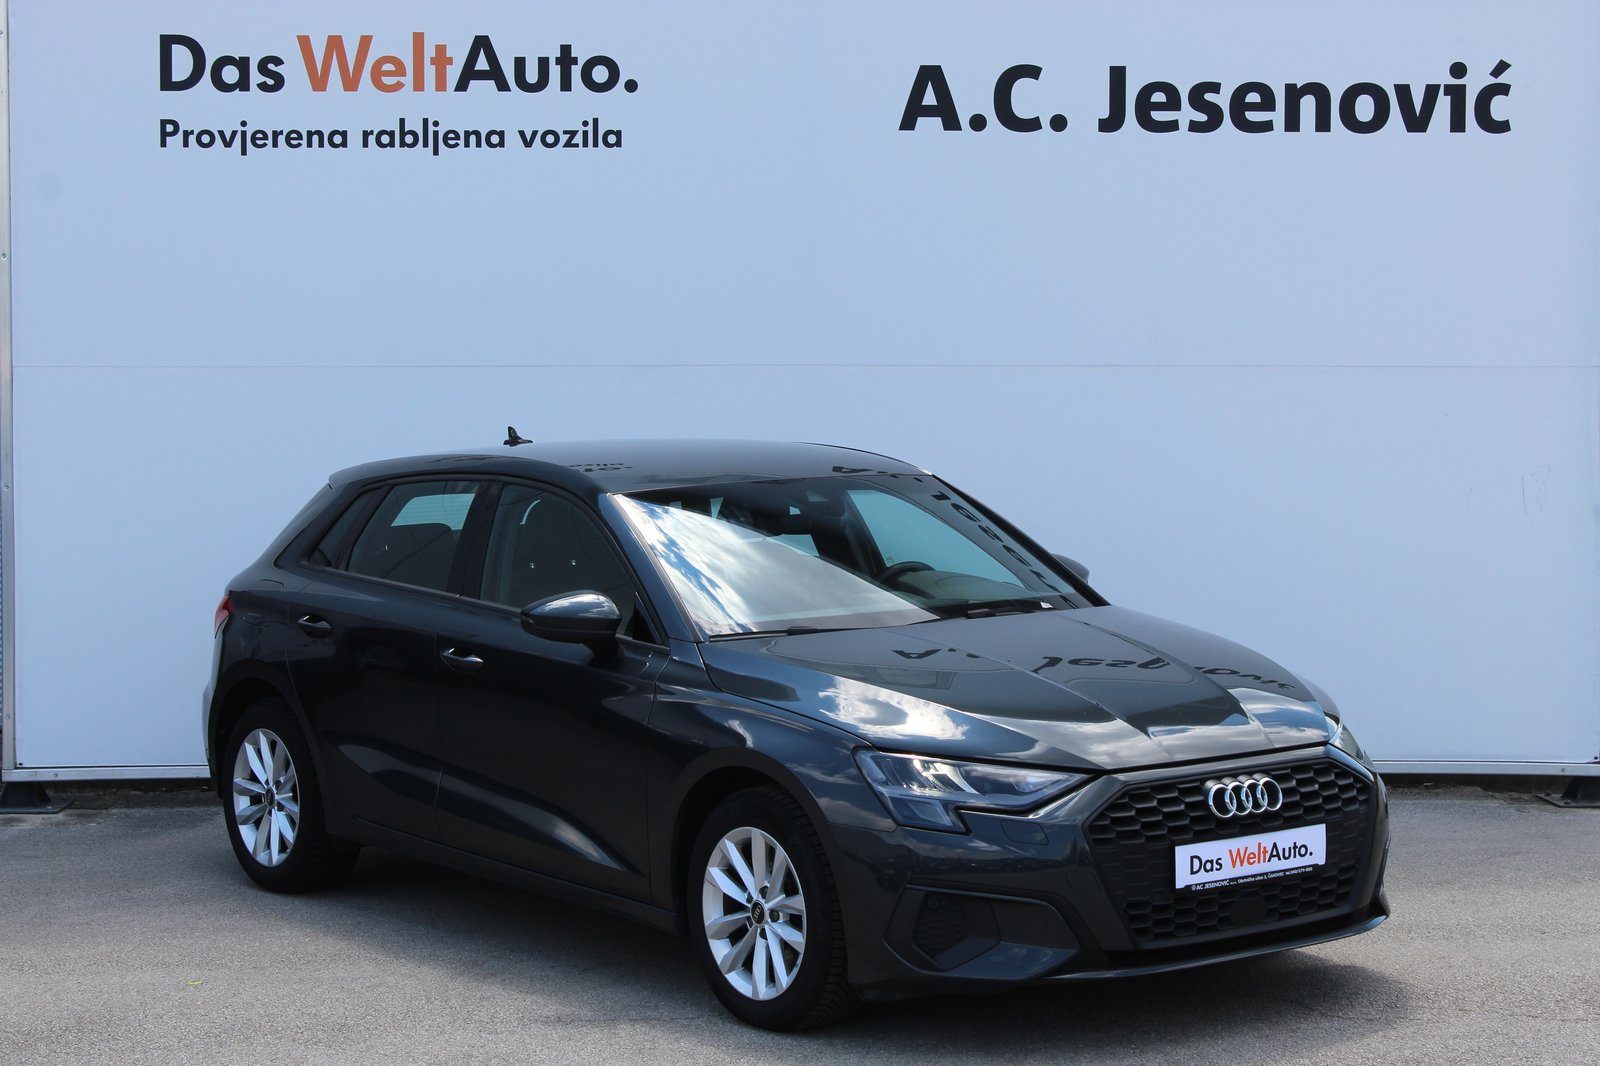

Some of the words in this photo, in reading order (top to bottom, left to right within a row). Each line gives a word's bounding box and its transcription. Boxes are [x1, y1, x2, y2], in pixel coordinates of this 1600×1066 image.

[160, 34, 285, 93] Das
[297, 32, 638, 93] WeltAuto.
[899, 64, 1068, 132] A.C.
[1098, 59, 1512, 134] Jesenović
[160, 119, 347, 156] Provjerena
[362, 118, 505, 156] rabljena
[518, 118, 622, 148] vozila
[1190, 855, 1222, 875] Das
[1229, 842, 1313, 868] WeltAuto.
